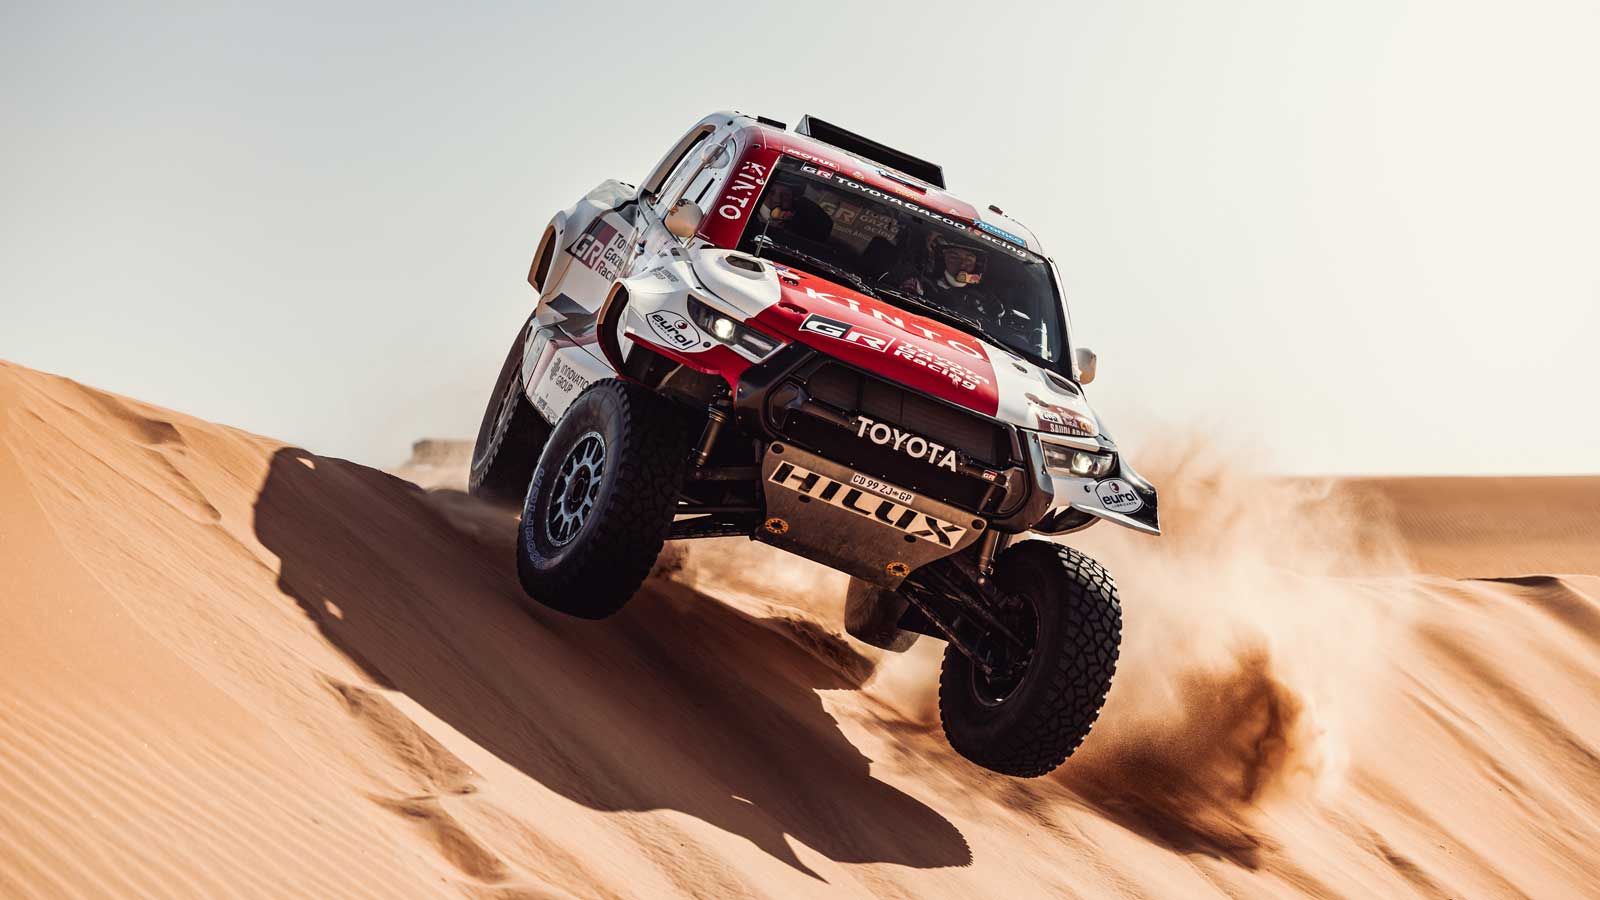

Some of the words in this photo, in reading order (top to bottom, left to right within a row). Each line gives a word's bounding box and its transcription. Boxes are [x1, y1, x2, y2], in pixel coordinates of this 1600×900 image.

[786, 149, 837, 168] MOTUL
[802, 165, 832, 178] GR
[719, 161, 767, 220] KINTO
[570, 232, 605, 269] GR
[652, 314, 695, 347] eurol
[804, 287, 984, 360] KINTO
[804, 320, 887, 350] GR
[893, 349, 977, 391] Racing
[897, 344, 982, 385] GAZOO
[901, 340, 989, 385] TOYOTA
[857, 415, 957, 473] TOYOTA
[772, 462, 963, 547] HILUX
[852, 474, 866, 486] CD
[867, 480, 880, 490] 99
[880, 484, 893, 496] ZJ
[898, 492, 913, 502] GP
[1102, 490, 1138, 505] eurol
